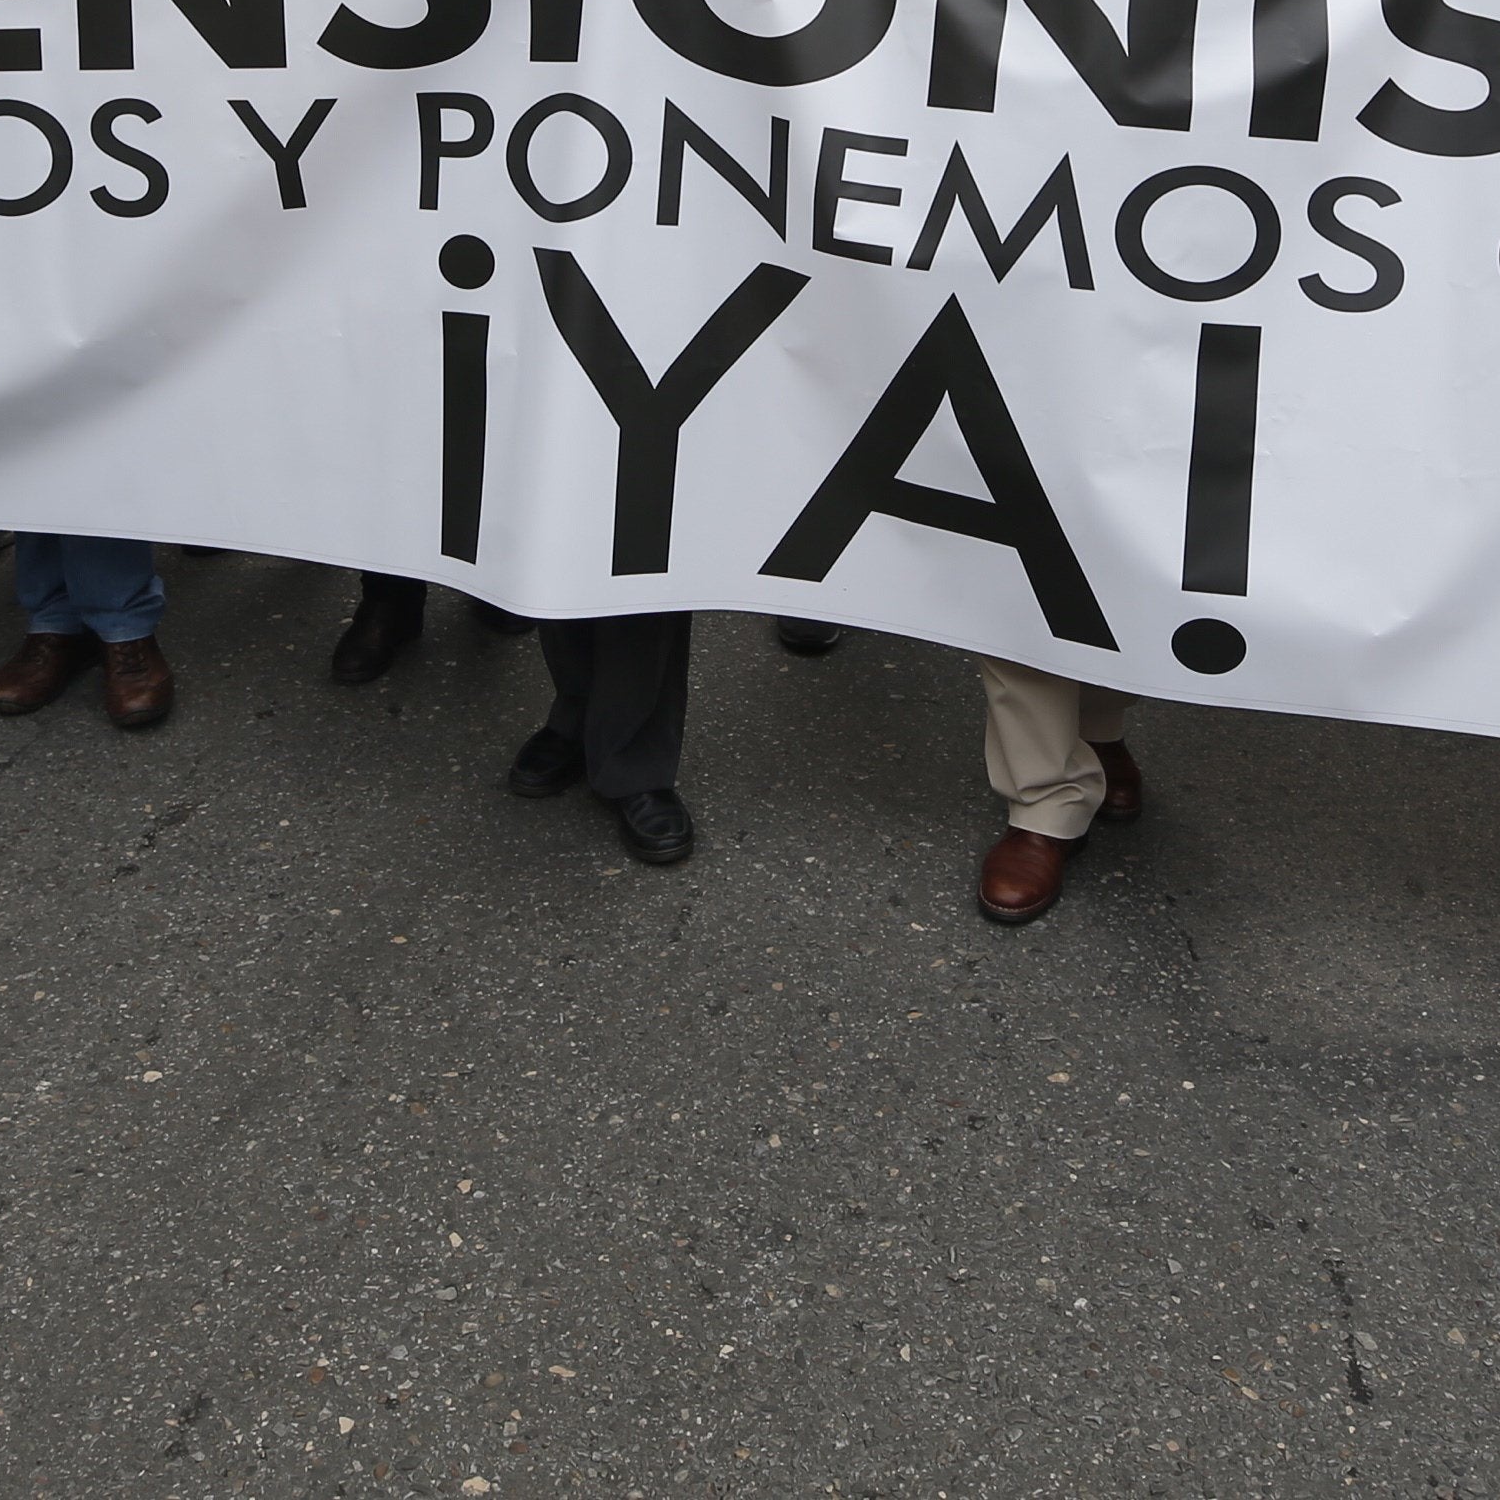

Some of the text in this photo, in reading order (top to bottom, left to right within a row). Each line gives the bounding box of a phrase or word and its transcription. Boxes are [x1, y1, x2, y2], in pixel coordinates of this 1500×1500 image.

[227, 99, 337, 210] Y
[416, 92, 1404, 312] PONEMOS
[439, 234, 1261, 674] ¡YA!
